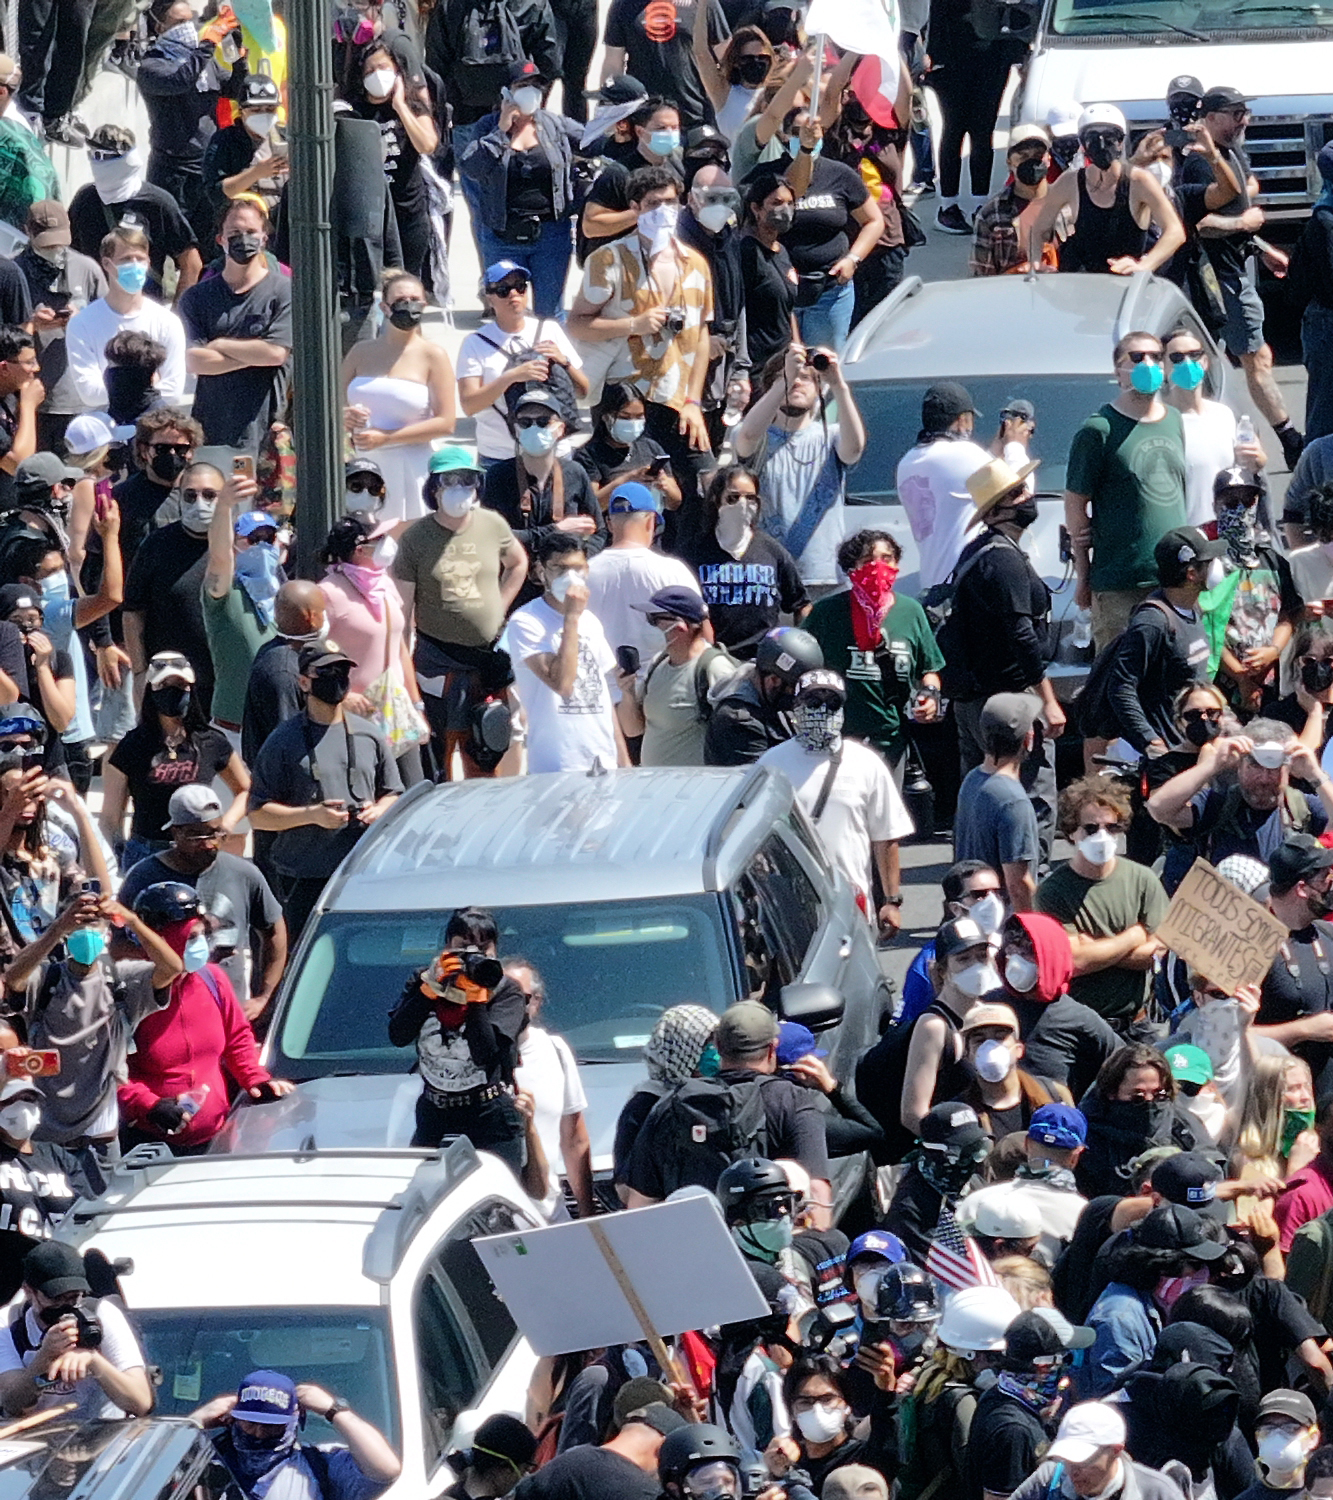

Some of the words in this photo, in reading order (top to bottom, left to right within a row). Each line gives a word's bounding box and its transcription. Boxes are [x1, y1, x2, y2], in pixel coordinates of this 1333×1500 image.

[1166, 897, 1255, 980] MIGRANTES
[1193, 867, 1243, 923] TODOS
[1243, 908, 1284, 959] SOMOS
